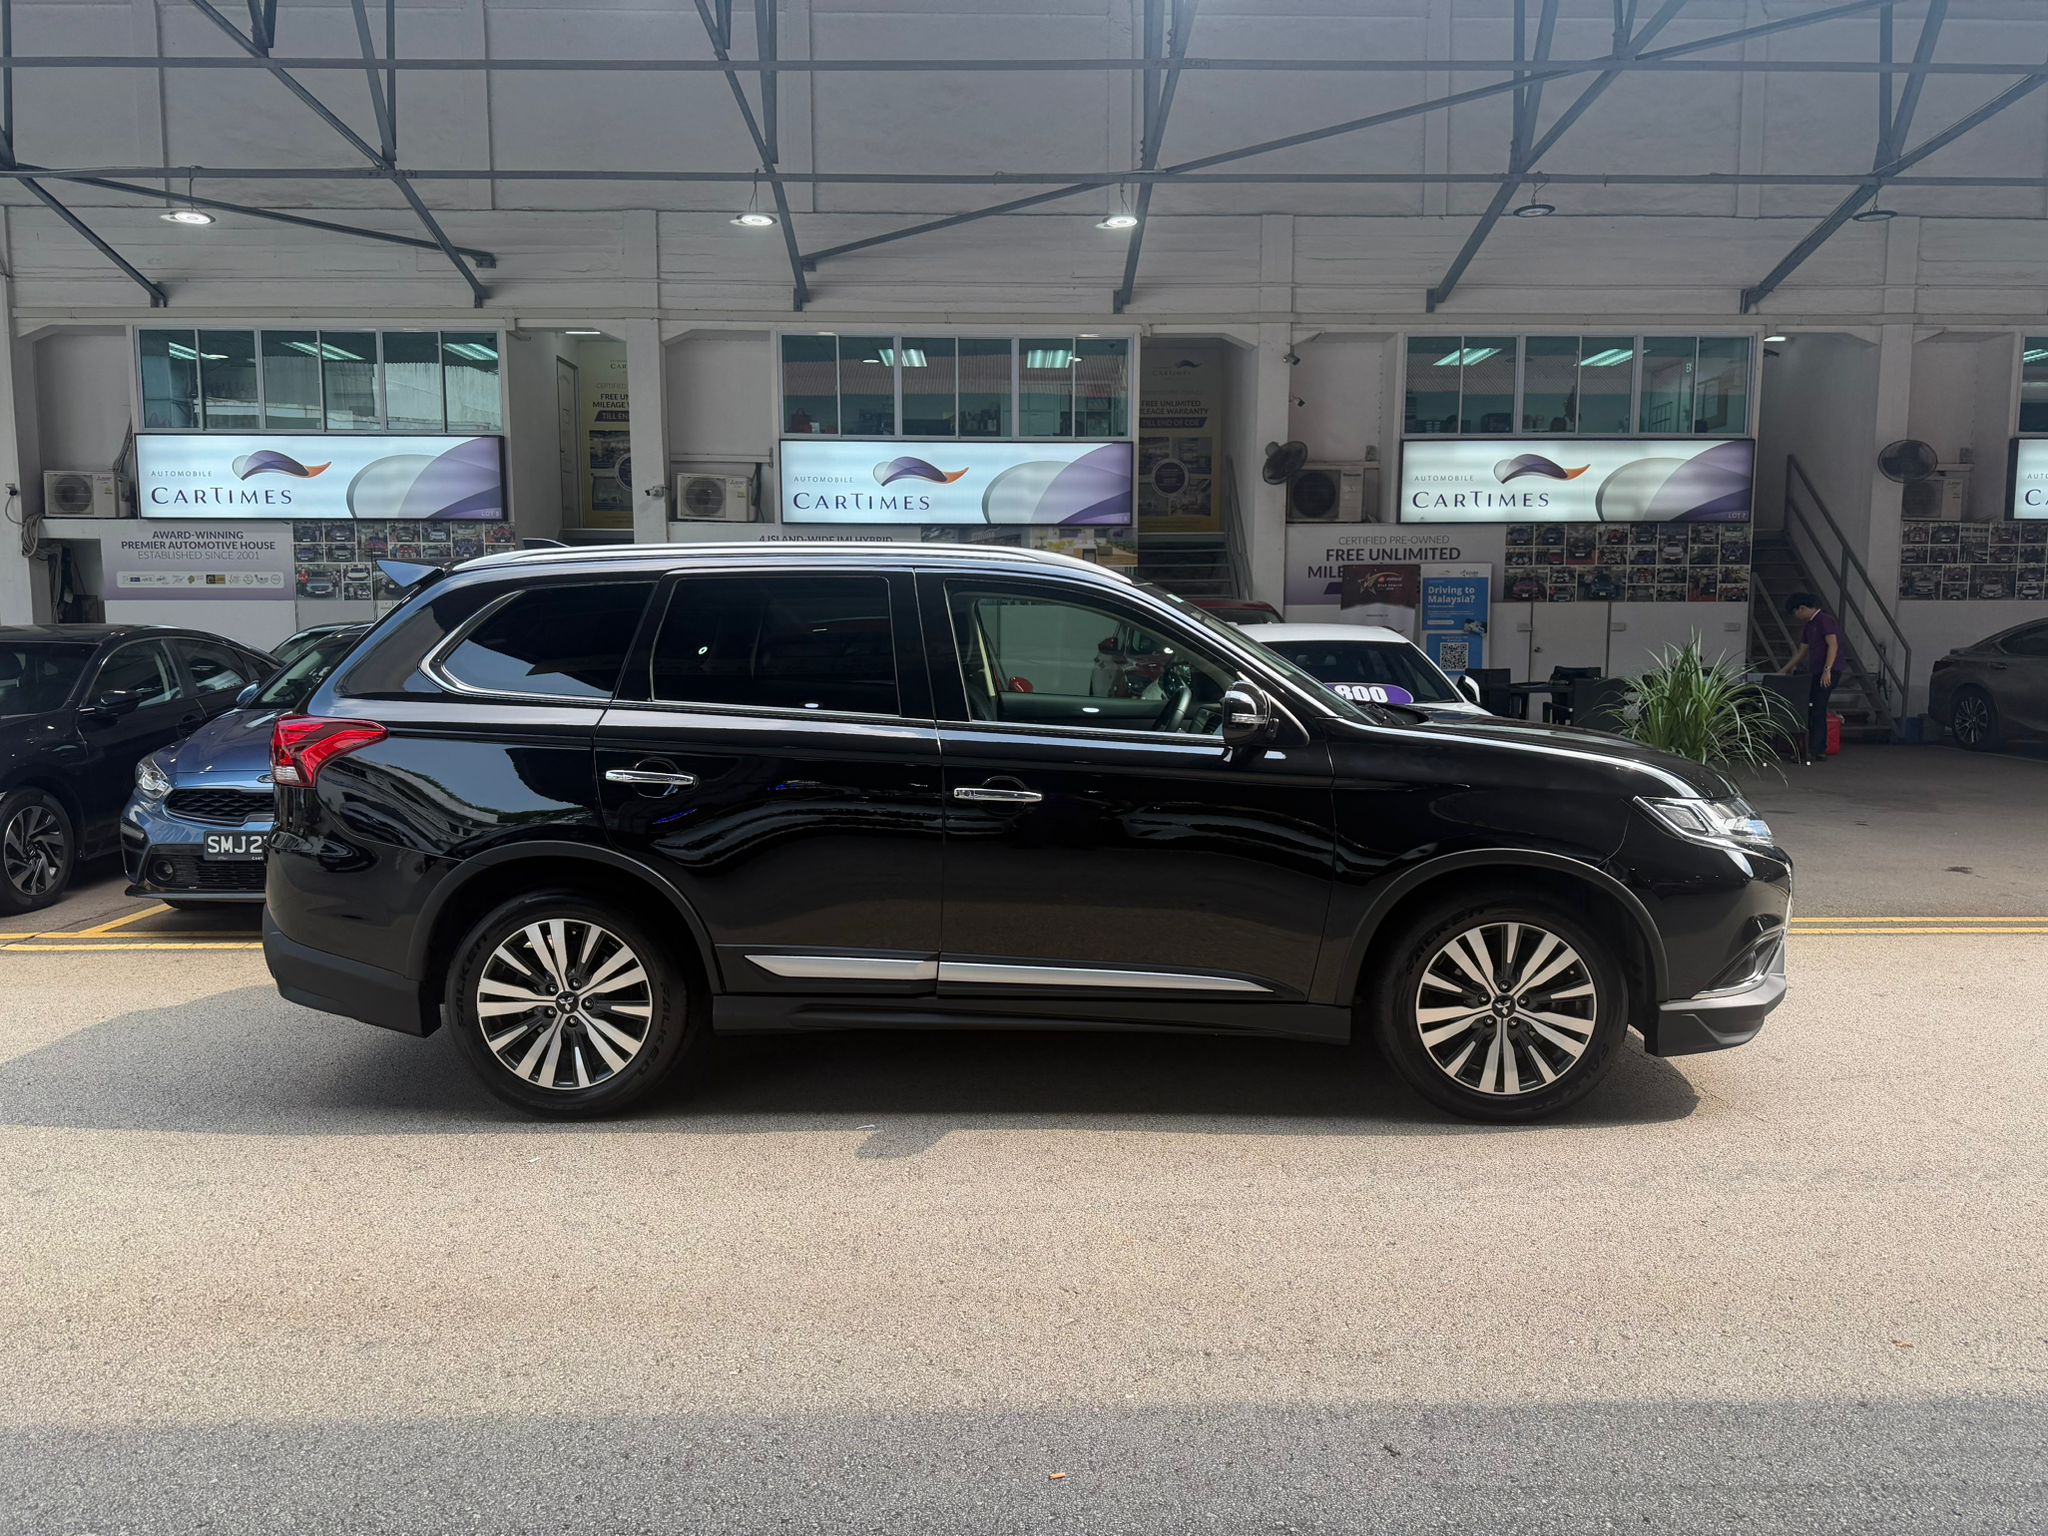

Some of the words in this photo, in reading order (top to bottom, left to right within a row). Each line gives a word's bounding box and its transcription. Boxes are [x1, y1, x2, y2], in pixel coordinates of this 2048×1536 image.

[600, 393, 619, 401] FREE
[593, 401, 626, 409] MILEAGE
[151, 486, 293, 505] CARTIMES
[1412, 491, 1550, 509] CARTIMES
[793, 492, 931, 511] CARTIMES
[152, 530, 244, 540] AWARD-WINNING
[1338, 535, 1387, 545] CERTIFIED
[1389, 535, 1450, 545] PRE-OWNED
[121, 541, 166, 550] PREMIER
[168, 541, 238, 550] AUTOMOTIVE
[240, 541, 275, 550] HOUSE
[138, 551, 202, 560] ESTABLISHED
[205, 551, 234, 560] SINCE
[236, 551, 260, 560] 2001
[1326, 548, 1365, 562] FREE
[1369, 547, 1461, 561] UNLIMITED
[1308, 566, 1343, 578] MILE
[1427, 586, 1463, 596] Driving
[1464, 586, 1475, 594] to
[1427, 595, 1475, 605] Malaysia?
[207, 835, 268, 854] SMJ2
